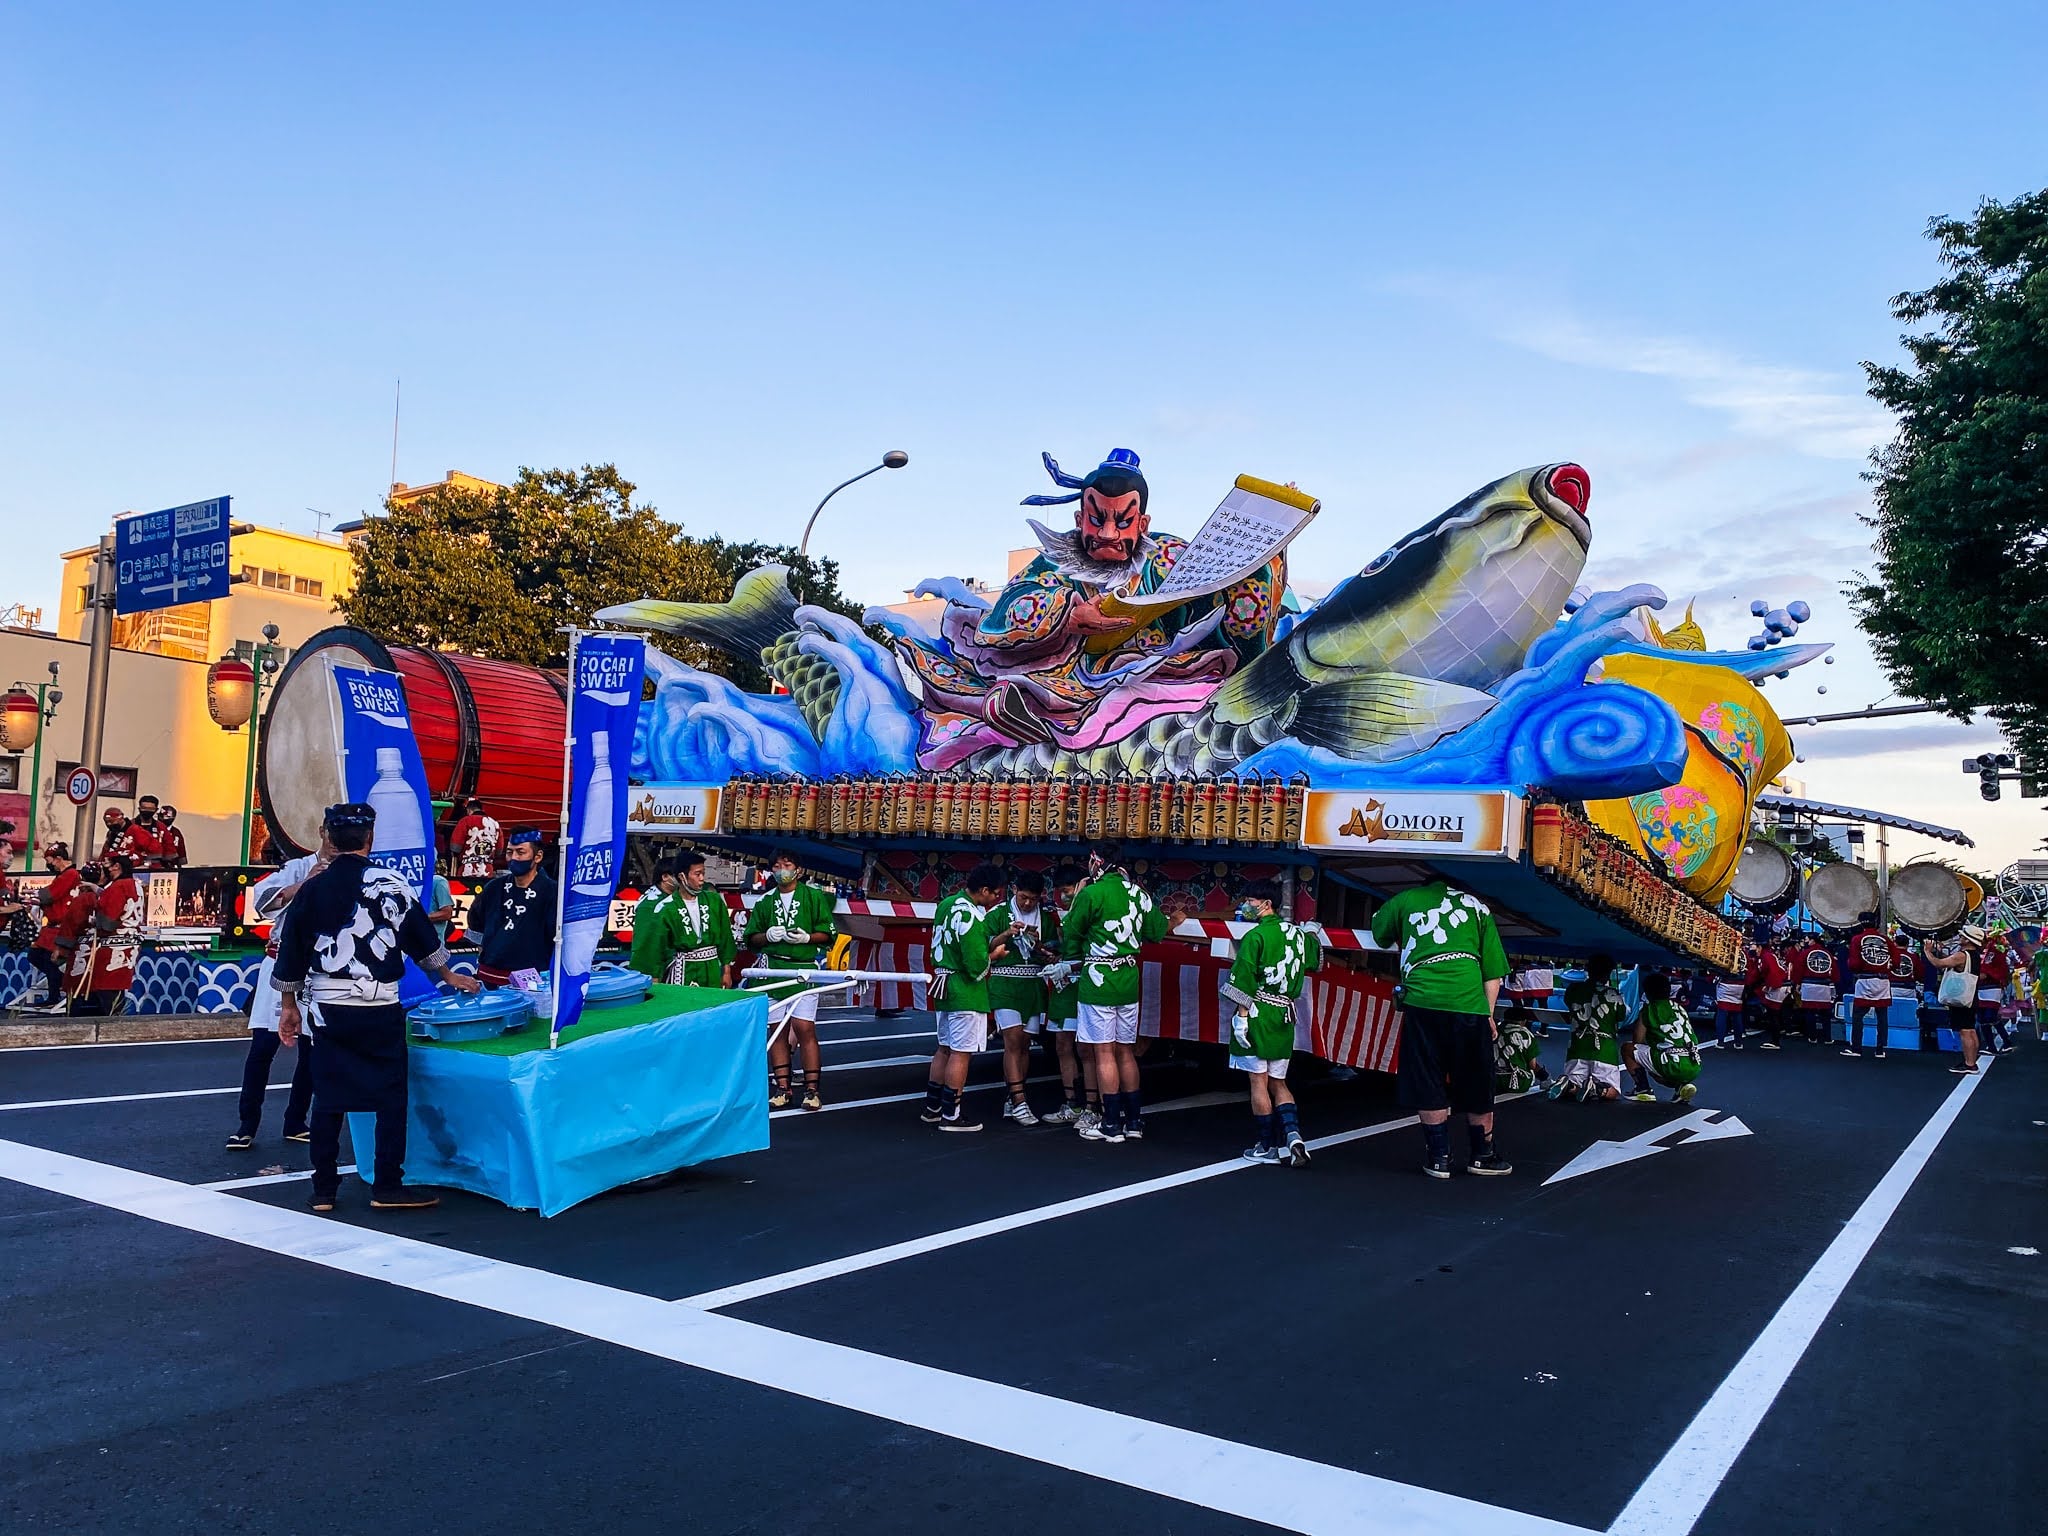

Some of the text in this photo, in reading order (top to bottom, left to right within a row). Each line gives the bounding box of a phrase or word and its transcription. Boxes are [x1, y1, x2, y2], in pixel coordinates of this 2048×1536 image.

[143, 514, 169, 531] 青森空港
[157, 530, 170, 539] Airport
[183, 545, 210, 563] 青森駅
[134, 552, 169, 573] 合浦公園
[172, 563, 178, 572] 16
[183, 564, 200, 573] Aomori
[154, 570, 164, 579] Park
[189, 577, 196, 587] 16
[581, 657, 634, 672] POCARI
[581, 673, 627, 688] SWEAT
[348, 682, 399, 701] POCARI
[353, 695, 399, 713] SWEAT
[73, 778, 89, 794] 50
[370, 854, 426, 870] OCARI
